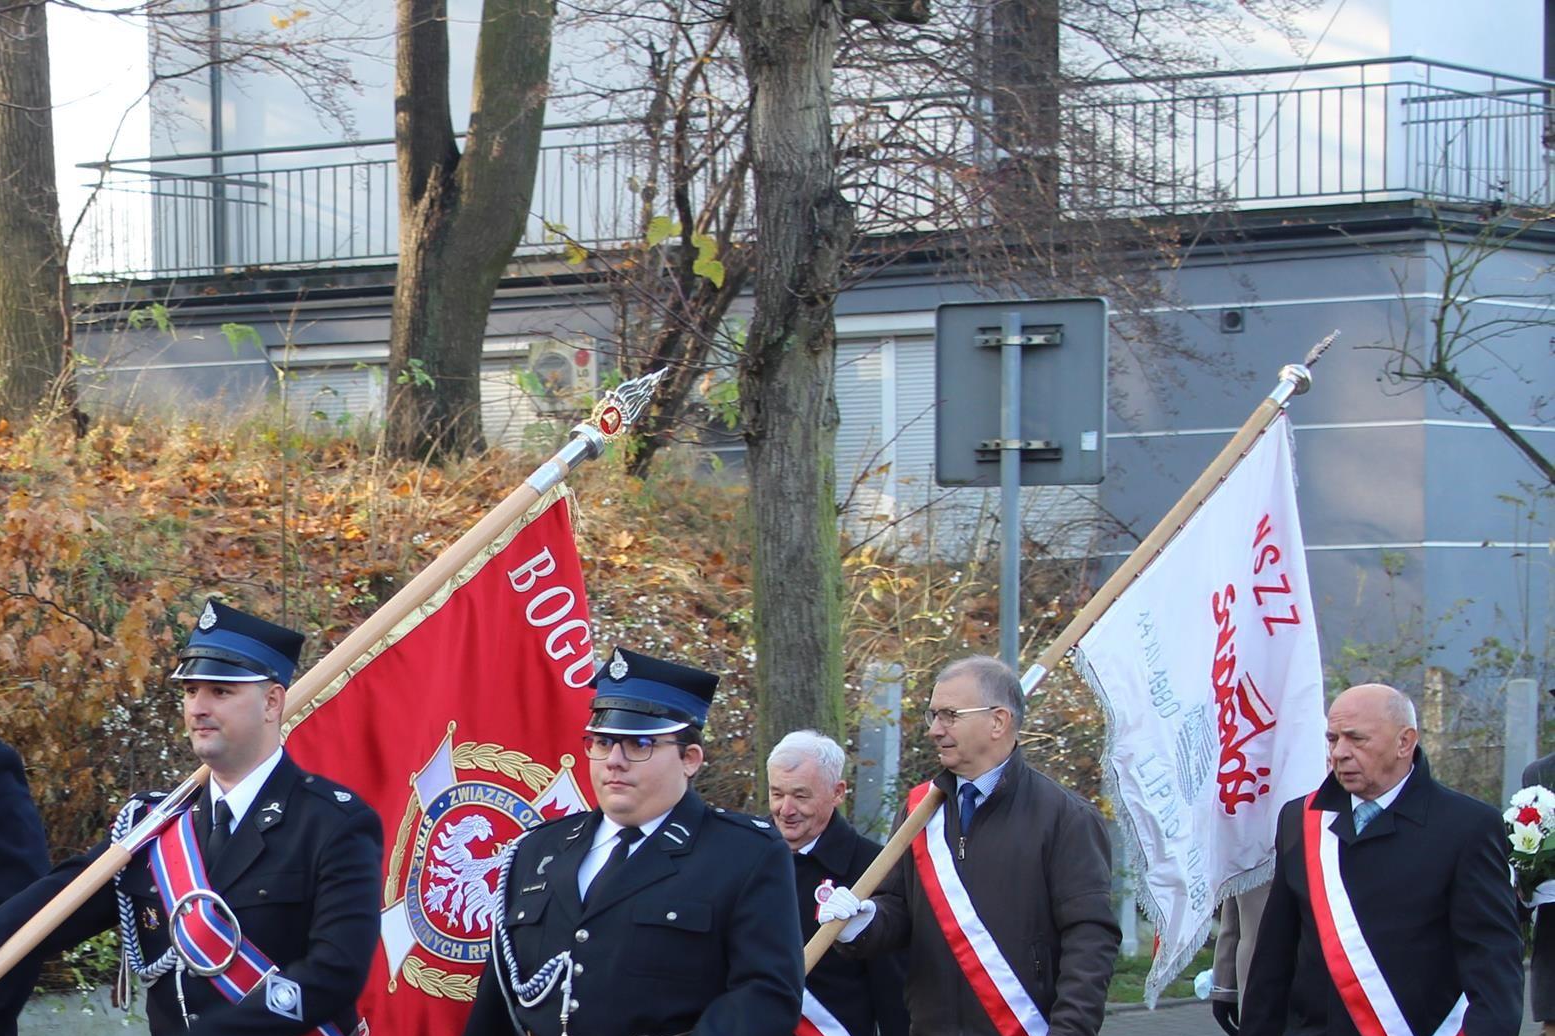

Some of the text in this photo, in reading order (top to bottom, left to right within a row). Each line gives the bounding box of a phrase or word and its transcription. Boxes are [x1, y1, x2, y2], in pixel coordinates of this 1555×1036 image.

[1252, 513, 1301, 637] NSZZ
[1148, 669, 1181, 719] 1980
[1136, 753, 1181, 839] LIPNO
[468, 944, 491, 959] RP
